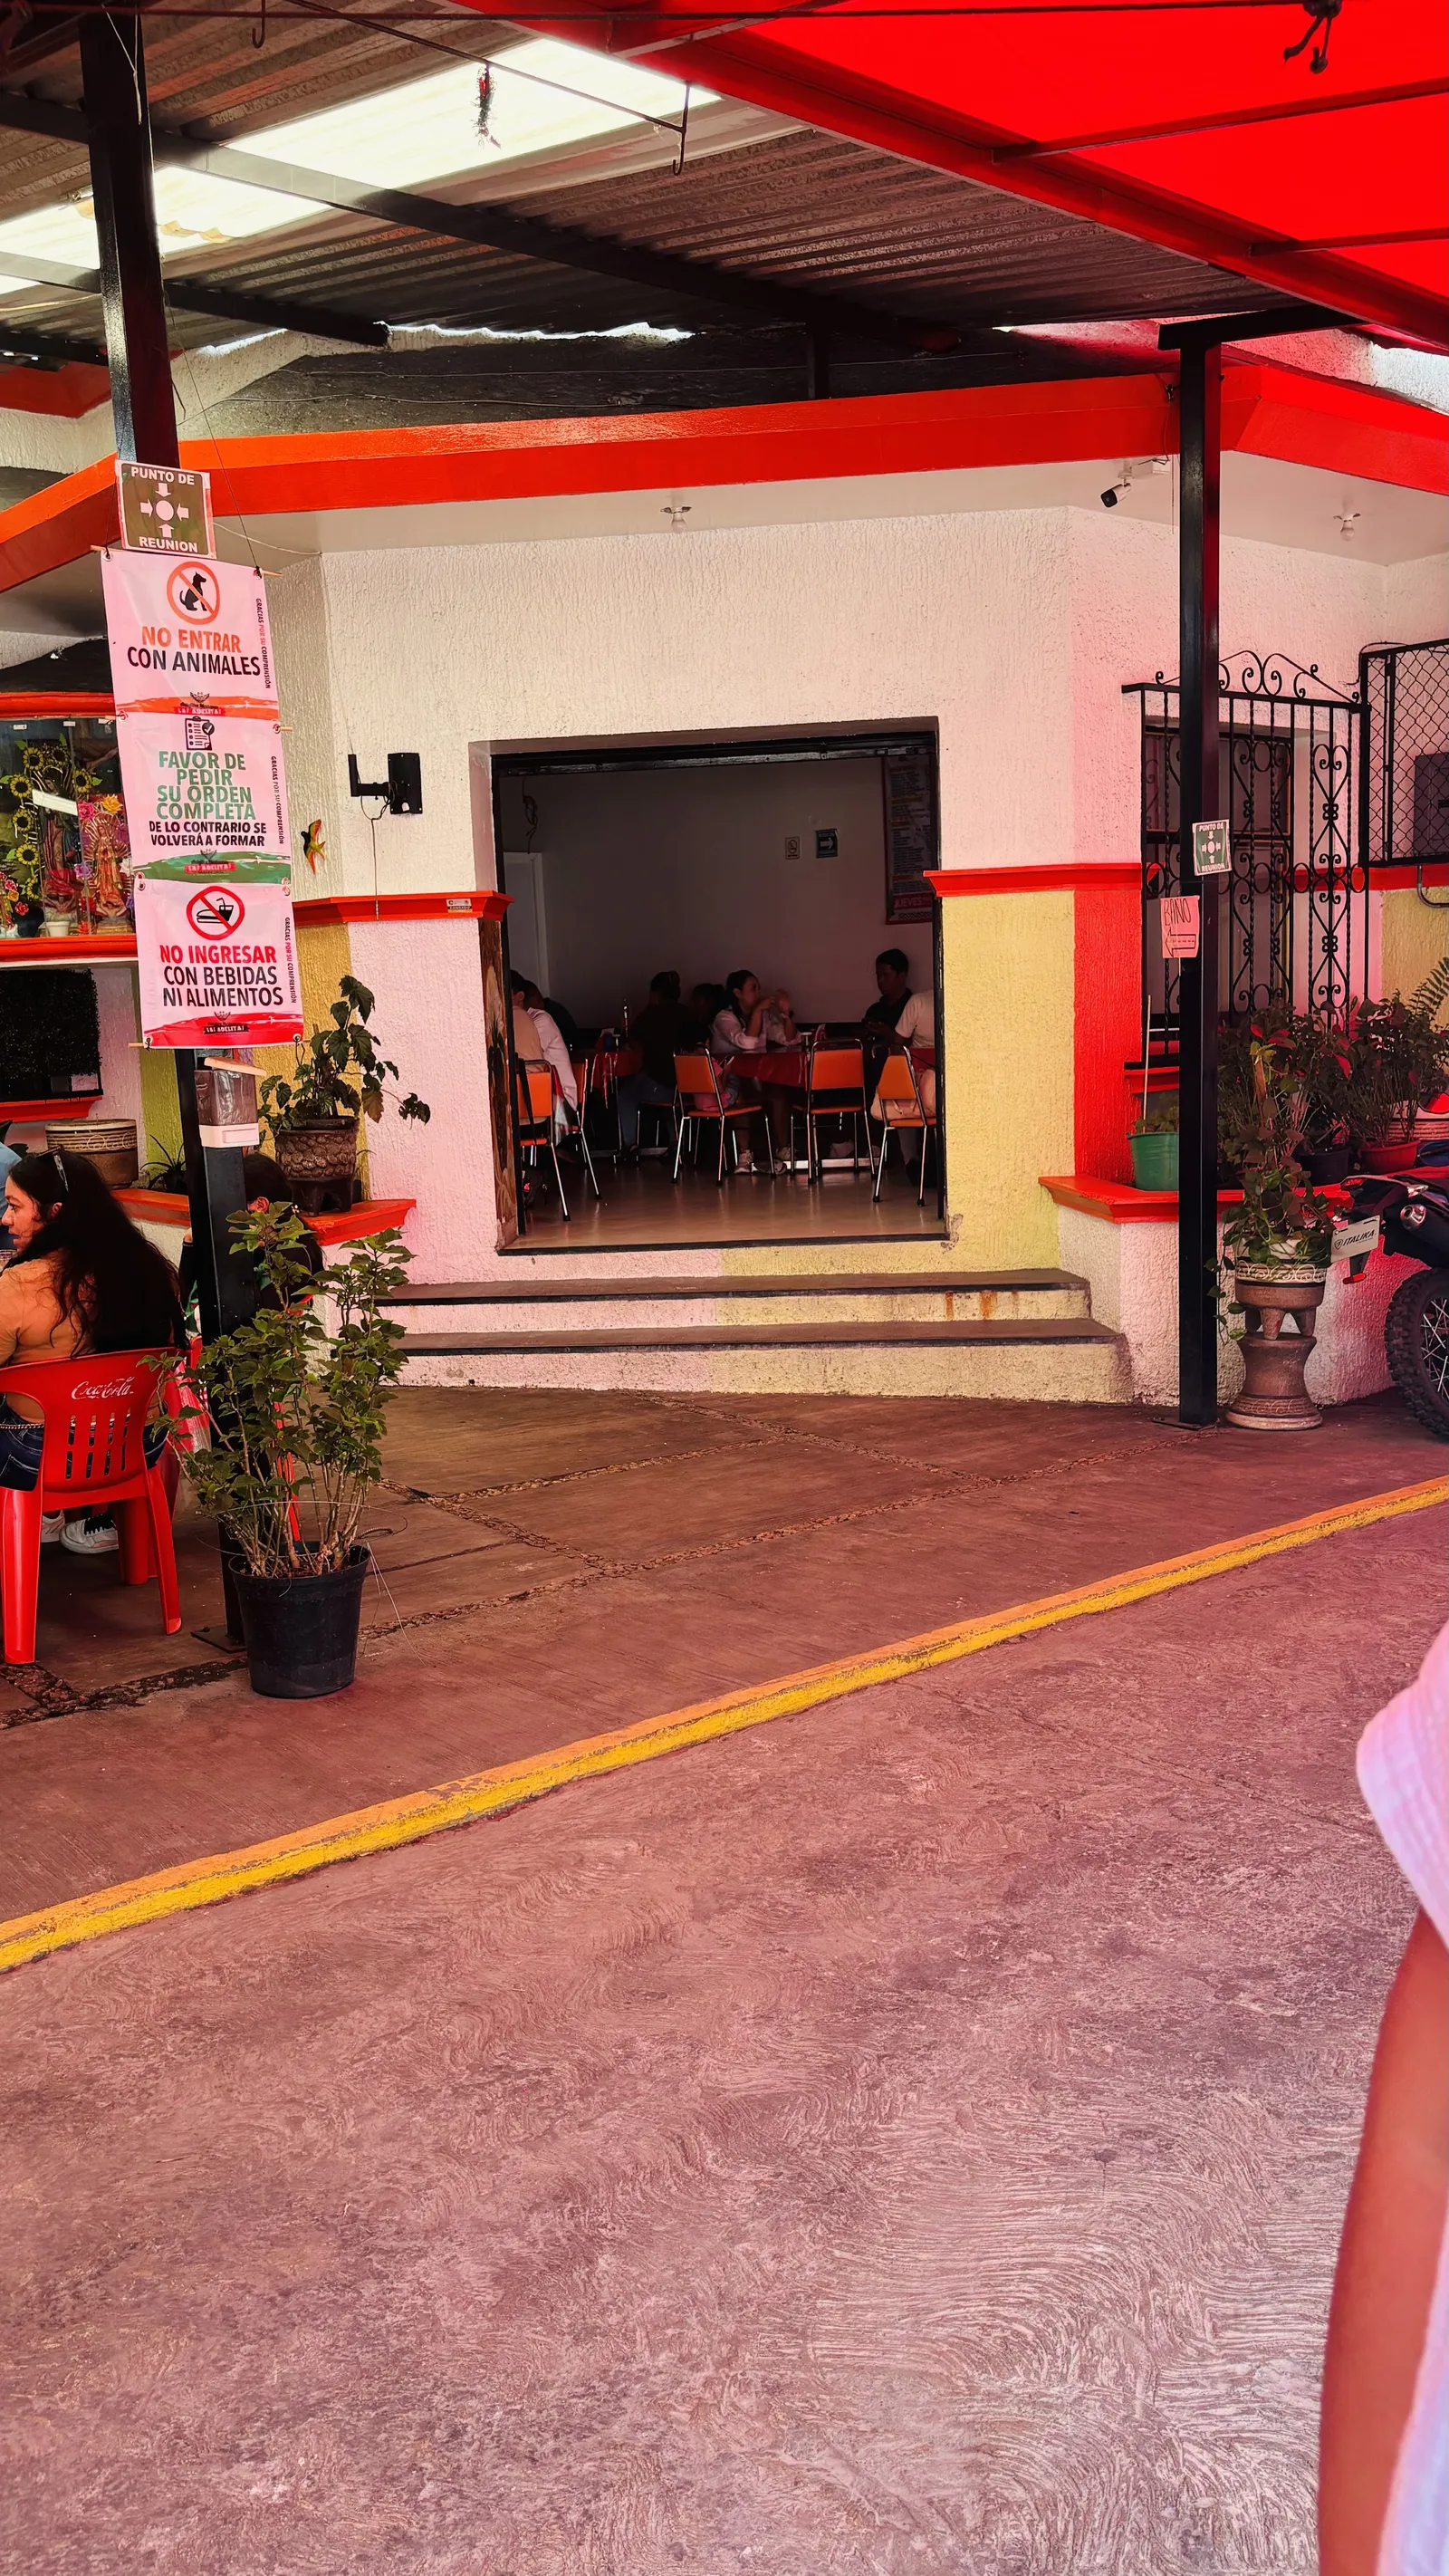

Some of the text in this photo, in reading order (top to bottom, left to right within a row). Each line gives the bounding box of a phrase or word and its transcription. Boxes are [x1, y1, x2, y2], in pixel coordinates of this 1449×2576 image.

[131, 466, 195, 485] PUNTO DE
[139, 536, 198, 553] REUNION
[256, 598, 264, 623] GRACIAS
[141, 626, 242, 653] NO ENTRAR
[127, 647, 261, 676] CON ANIMALES
[158, 751, 246, 771] FAVOR DE
[177, 768, 233, 786] PEDIR
[157, 785, 252, 803] SU ORDEN
[156, 803, 256, 821] COMPLETA
[149, 821, 267, 834] DE LO CONTRARIO SE
[276, 803, 284, 844] COMPRENSIÓN
[1199, 823, 1216, 831] PUNTO
[150, 831, 265, 847] VOLVERÁ A FORMAR
[160, 945, 277, 965] NO INGRESAR
[164, 966, 277, 985] CON BEBIDAS
[163, 986, 283, 1007] NI ALIMENTOS
[1343, 1229, 1375, 1246] ITALIKA
